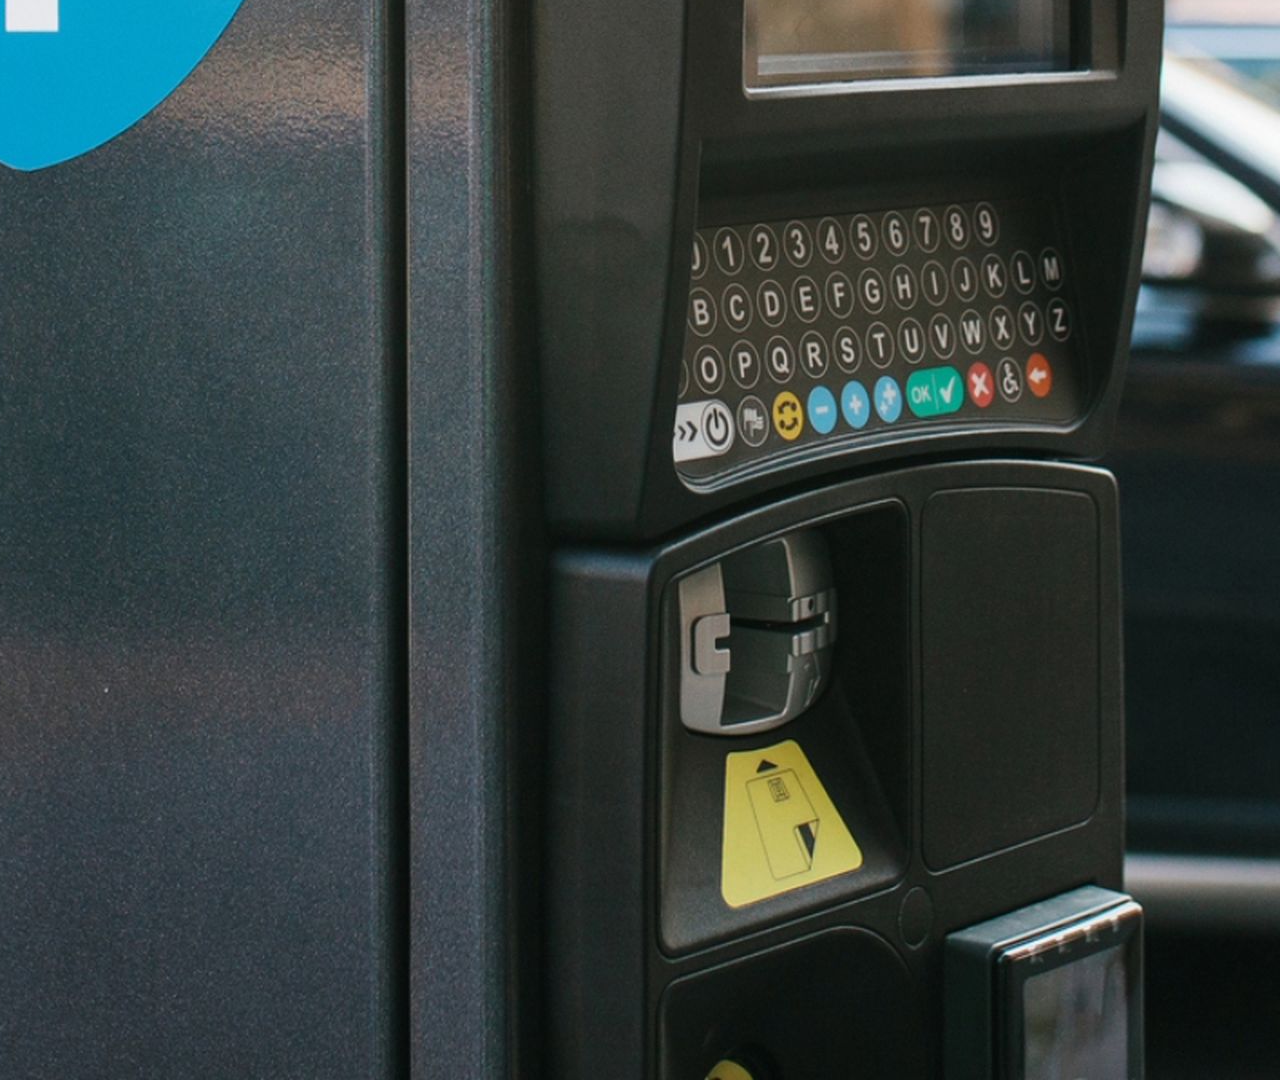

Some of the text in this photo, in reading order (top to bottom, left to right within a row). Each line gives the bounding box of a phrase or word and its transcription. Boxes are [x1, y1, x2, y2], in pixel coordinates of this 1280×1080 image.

[722, 236, 735, 267] 1
[756, 232, 772, 263] 2
[791, 229, 806, 259] 3
[825, 225, 839, 255] 4
[857, 222, 871, 252] 5
[889, 219, 903, 249] 6
[919, 215, 931, 245] 7
[950, 213, 964, 242] 8
[979, 210, 993, 239] 9
[693, 299, 710, 326] B
[729, 294, 745, 321] C
[764, 290, 780, 317] D
[799, 286, 814, 312] E
[833, 282, 845, 308] F
[864, 278, 880, 304] G
[896, 274, 912, 299] H
[960, 267, 970, 292] J
[987, 264, 1002, 288] K
[1017, 261, 1031, 285] L
[1044, 257, 1059, 281] M
[701, 308, 1066, 383] O P Q R S T U V W X Y Z
[911, 385, 932, 404] OK
